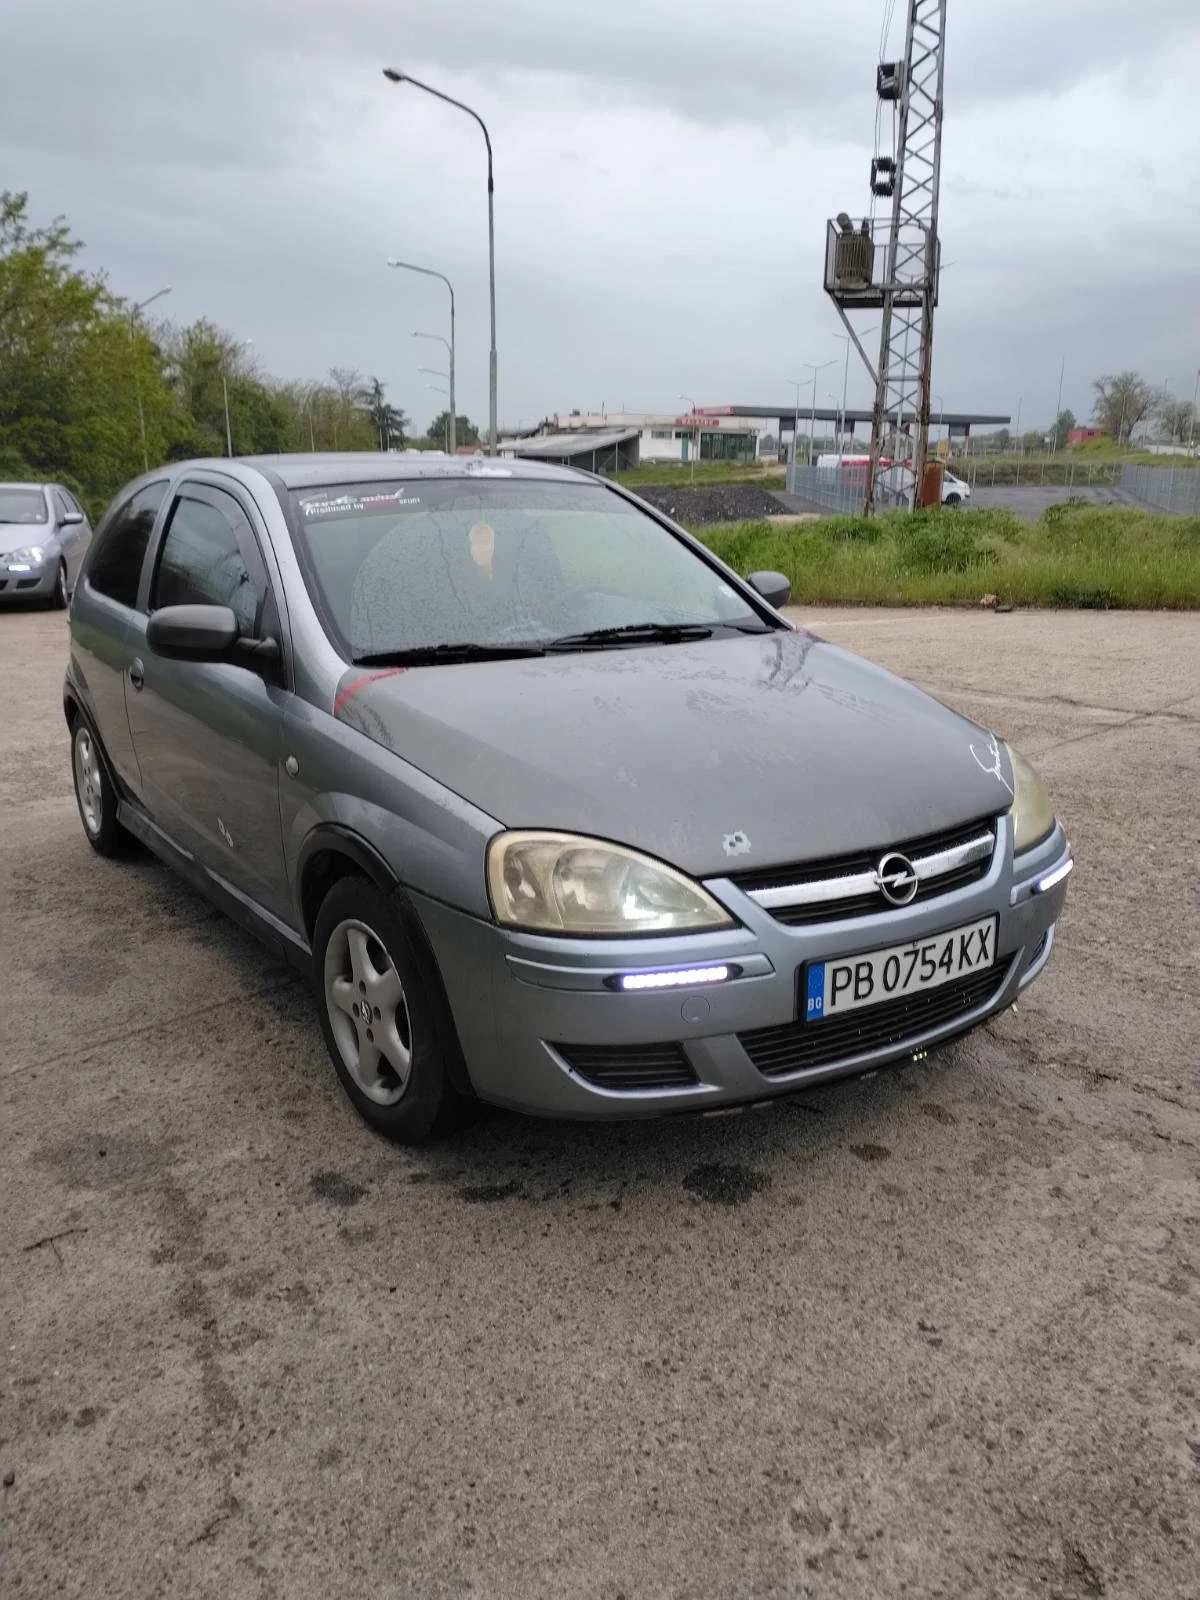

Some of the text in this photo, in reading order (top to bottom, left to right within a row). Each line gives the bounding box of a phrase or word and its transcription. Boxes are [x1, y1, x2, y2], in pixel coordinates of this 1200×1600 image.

[830, 925, 992, 1007] PB 0754 KX
[807, 996, 822, 1011] BG
